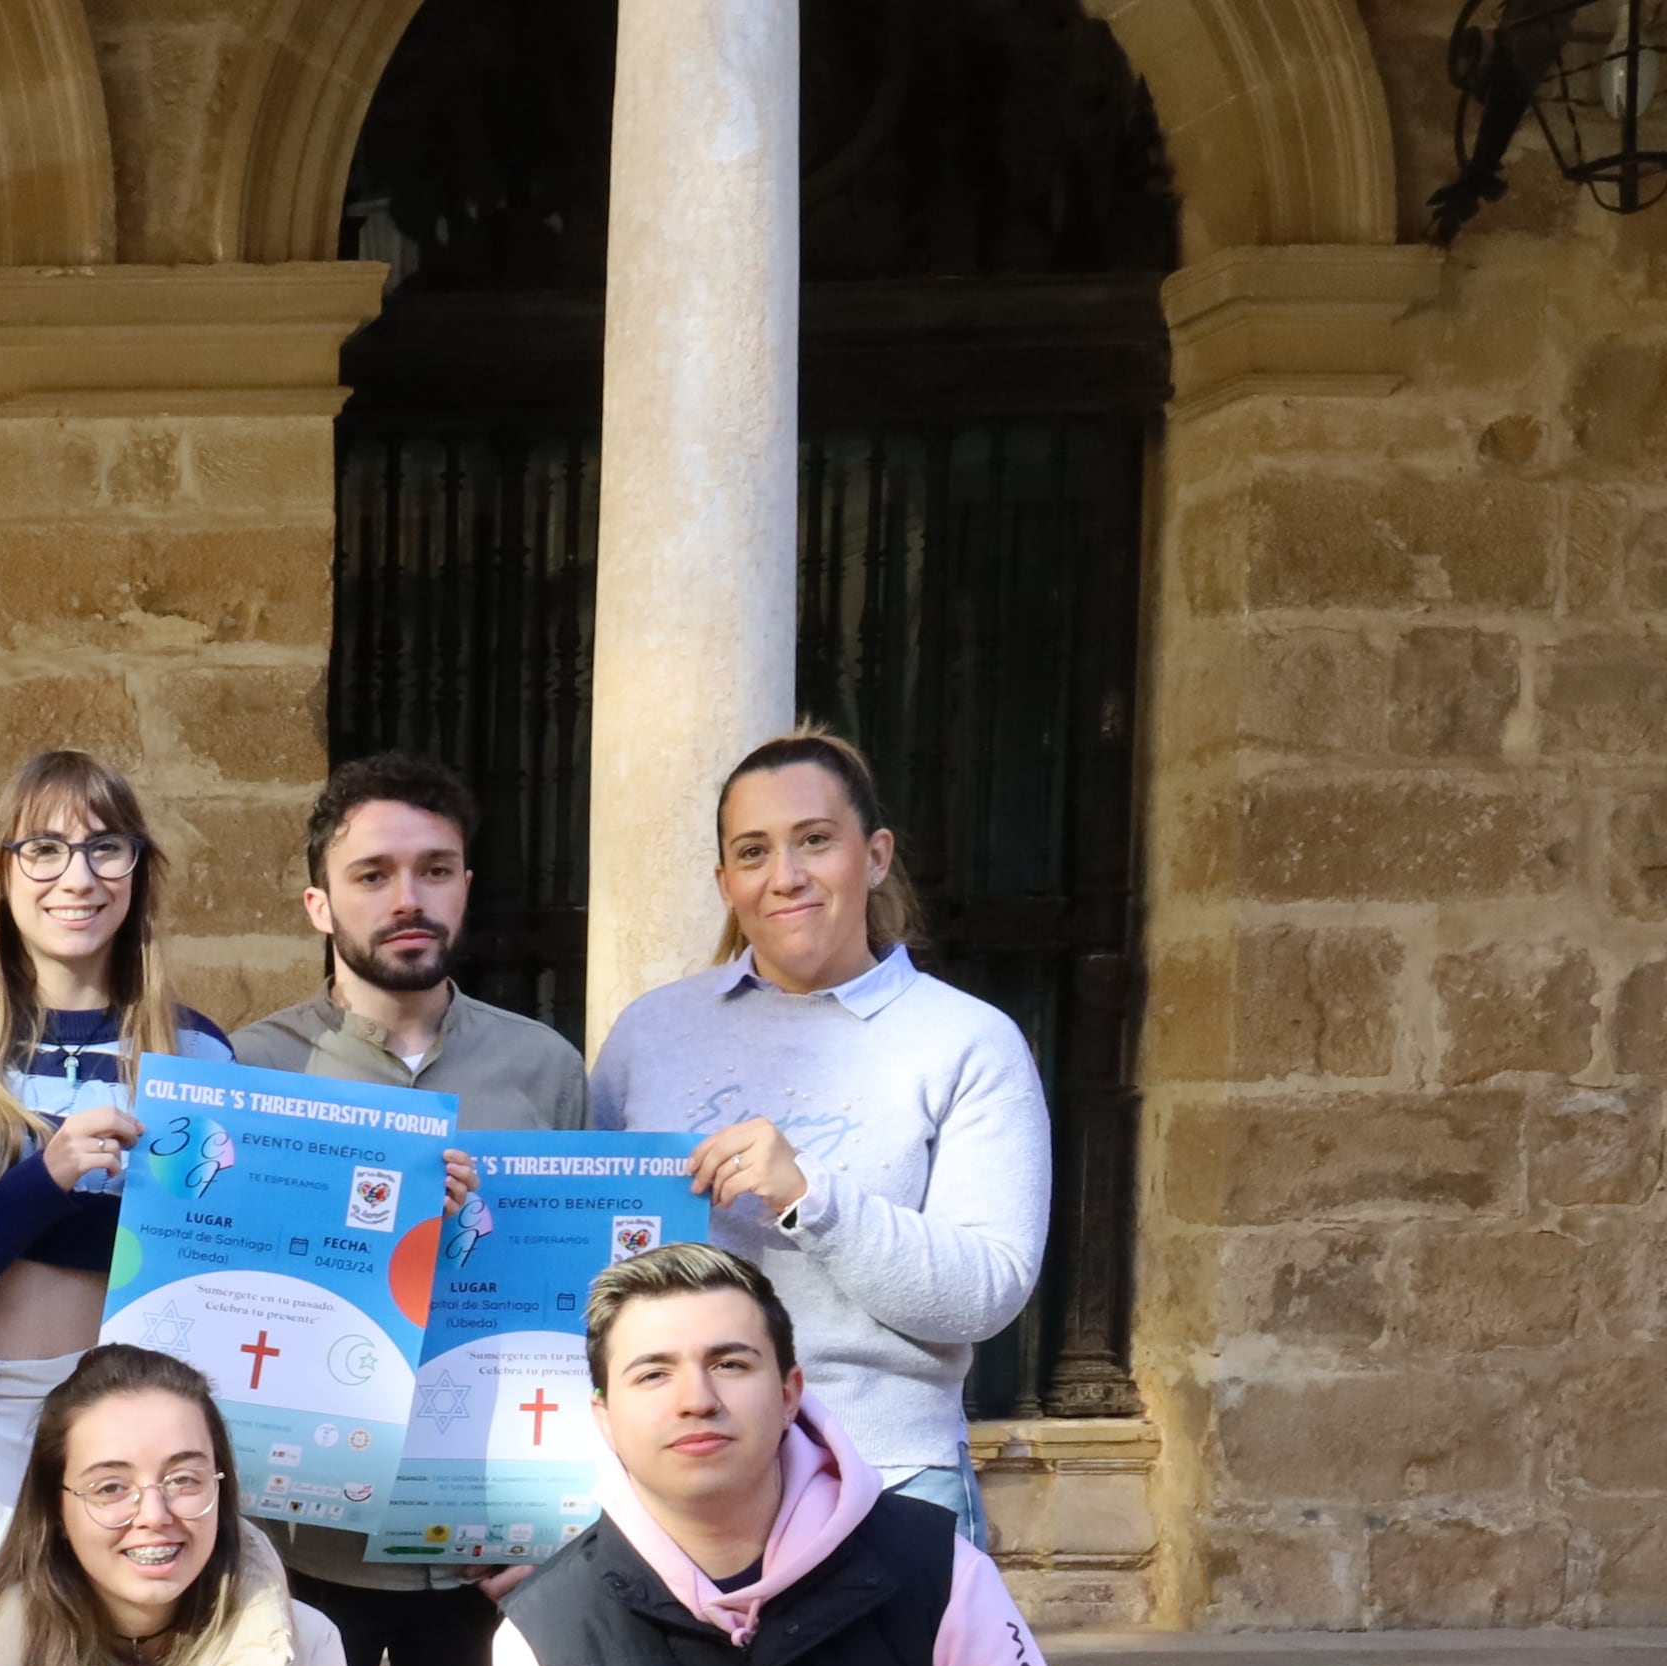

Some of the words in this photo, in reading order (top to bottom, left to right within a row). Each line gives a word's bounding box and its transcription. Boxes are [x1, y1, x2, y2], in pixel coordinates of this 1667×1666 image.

[145, 1079, 224, 1106] CULTURE
[251, 1093, 380, 1127] THREEVERSITY
[384, 1111, 448, 1137] FORUM
[242, 1133, 303, 1152] EVENTO
[308, 1140, 386, 1163] BENÉFICO
[503, 1157, 634, 1176] THREEVERSITY
[639, 1158, 693, 1177] FORU
[249, 1173, 262, 1182] TE
[265, 1175, 329, 1191] ESPERAMOS
[498, 1199, 560, 1209] EVENTO
[566, 1197, 643, 1210] BENÉFICO
[185, 1211, 232, 1228] LUGAR
[140, 1224, 192, 1241] Hospital
[196, 1231, 211, 1243] de
[215, 1233, 273, 1252] Santiago
[324, 1236, 371, 1254] FECHA:
[524, 1236, 589, 1245] ESPERAMOS
[315, 1256, 374, 1274] 04/03/24
[450, 1282, 497, 1293] LUGAR
[205, 1301, 248, 1315] Celebra
[252, 1309, 263, 1317] tu
[278, 1297, 289, 1305] tu
[430, 1300, 459, 1312] pital
[462, 1300, 477, 1310] de
[482, 1301, 539, 1312] Santiago
[551, 1352, 562, 1360] tu
[479, 1366, 522, 1375] Celebra
[526, 1367, 538, 1375] tu
